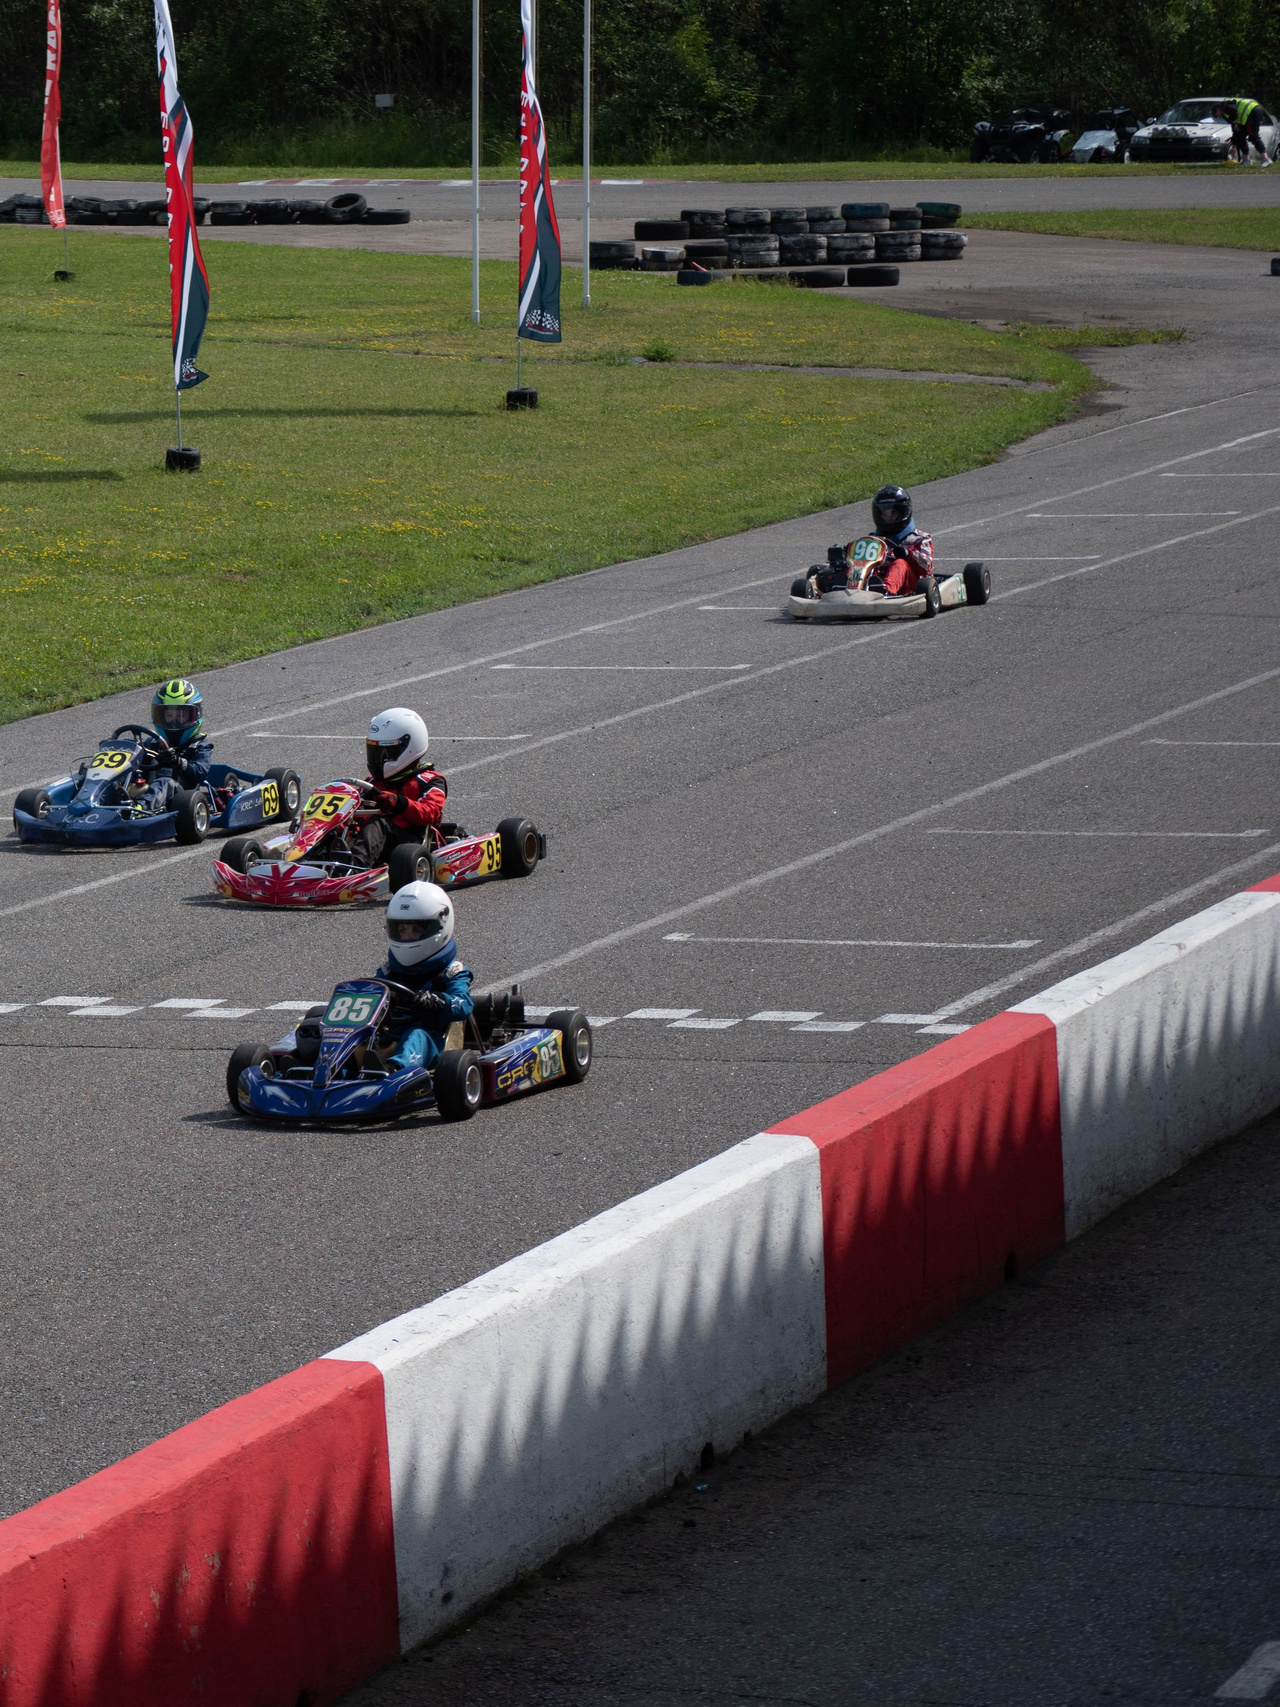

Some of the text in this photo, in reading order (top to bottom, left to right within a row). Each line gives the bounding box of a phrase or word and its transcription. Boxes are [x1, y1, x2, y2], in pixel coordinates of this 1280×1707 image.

[854, 541, 879, 561] 96
[90, 752, 127, 768] 69
[263, 784, 277, 815] 69
[306, 795, 345, 816] 95
[487, 837, 500, 871] 95
[328, 996, 374, 1022] 85
[540, 1040, 560, 1078] 85
